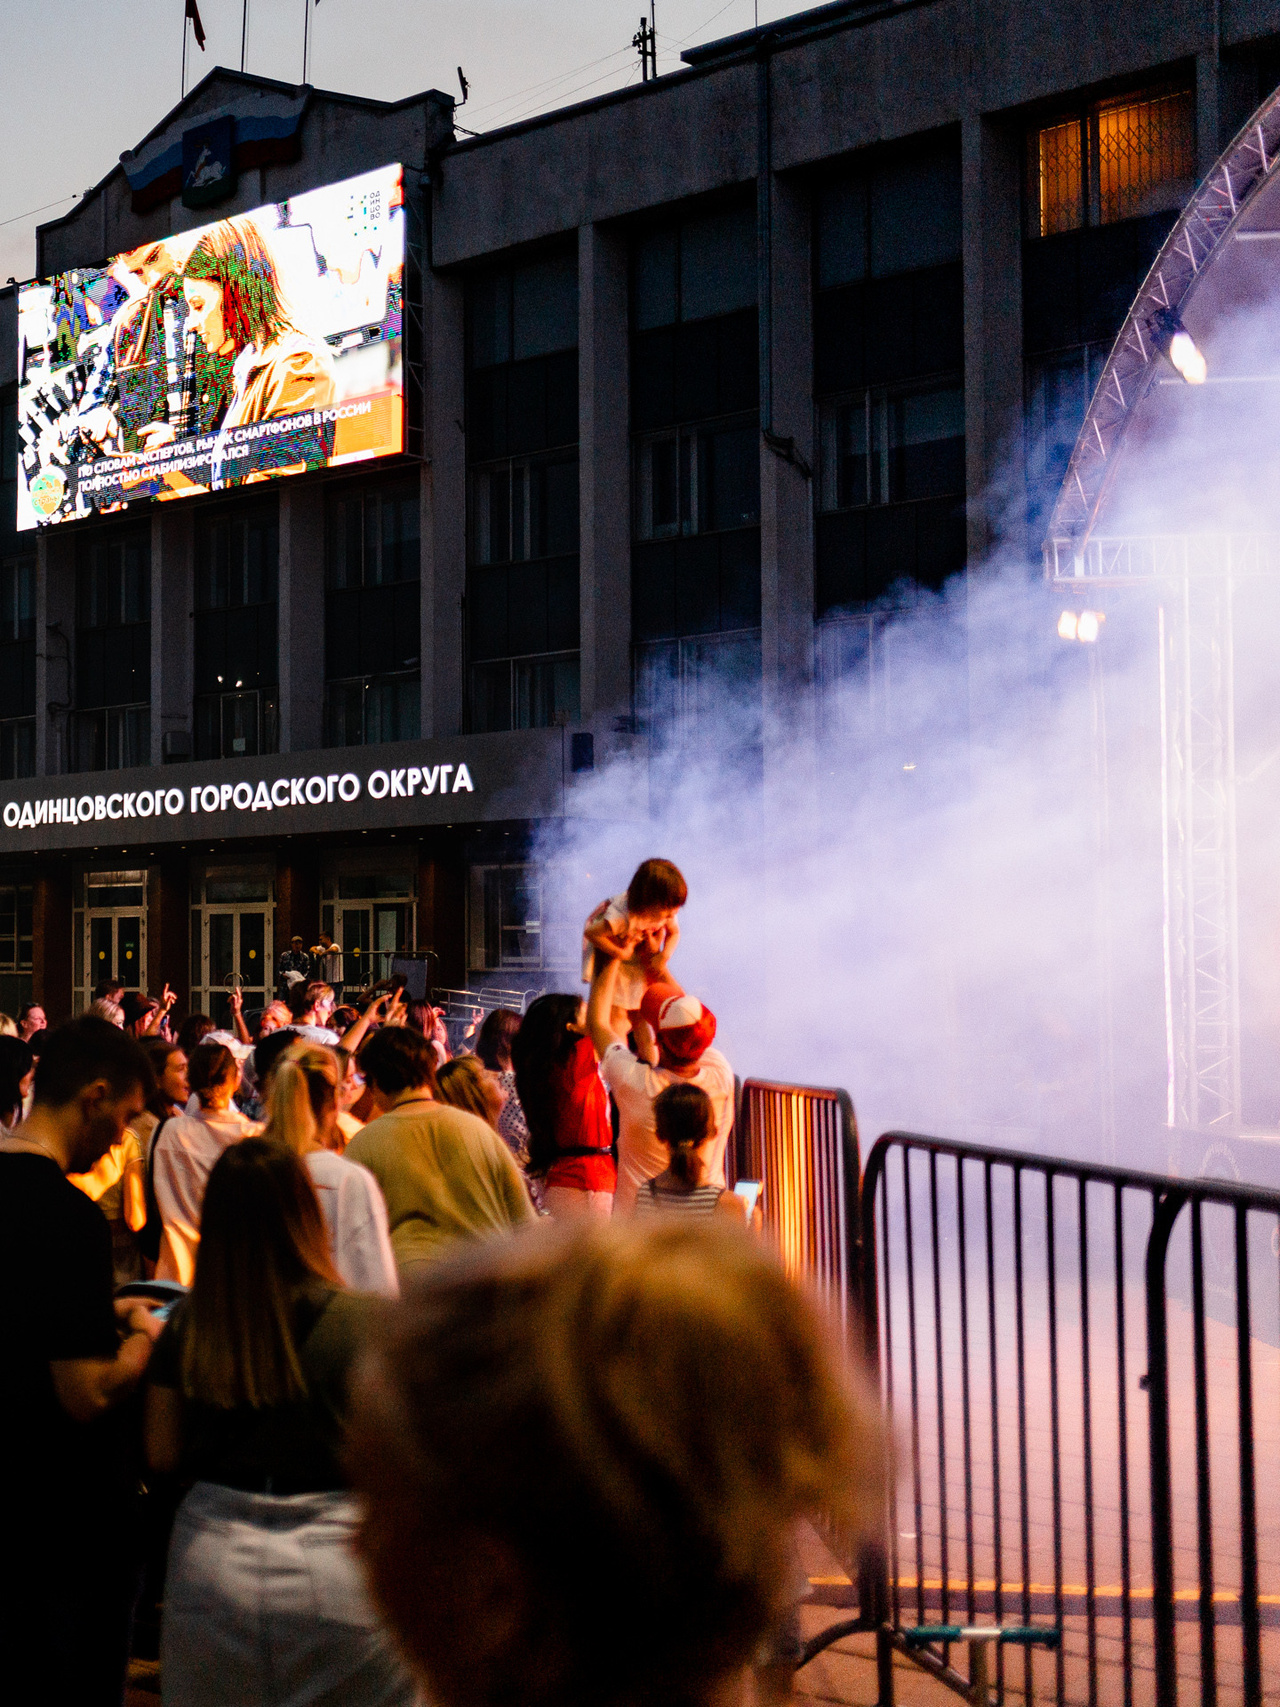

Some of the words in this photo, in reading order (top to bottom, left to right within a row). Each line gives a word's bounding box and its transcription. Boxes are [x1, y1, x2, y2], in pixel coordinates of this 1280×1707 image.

[370, 212, 380, 220] ВО
[93, 455, 136, 474] СЛОВАМ
[196, 431, 234, 451] РЫНК
[234, 414, 313, 440] СМАРТФОНОВ
[313, 413, 321, 425] В
[322, 401, 372, 423] РОССИИ
[141, 444, 249, 478] СТАБИЛИЗИРОАЛСЯ
[3, 788, 184, 829] ОДИНЦОВСКОГО
[190, 773, 360, 813] ГОРОДСКОГО
[367, 763, 474, 799] ОКРУГА
